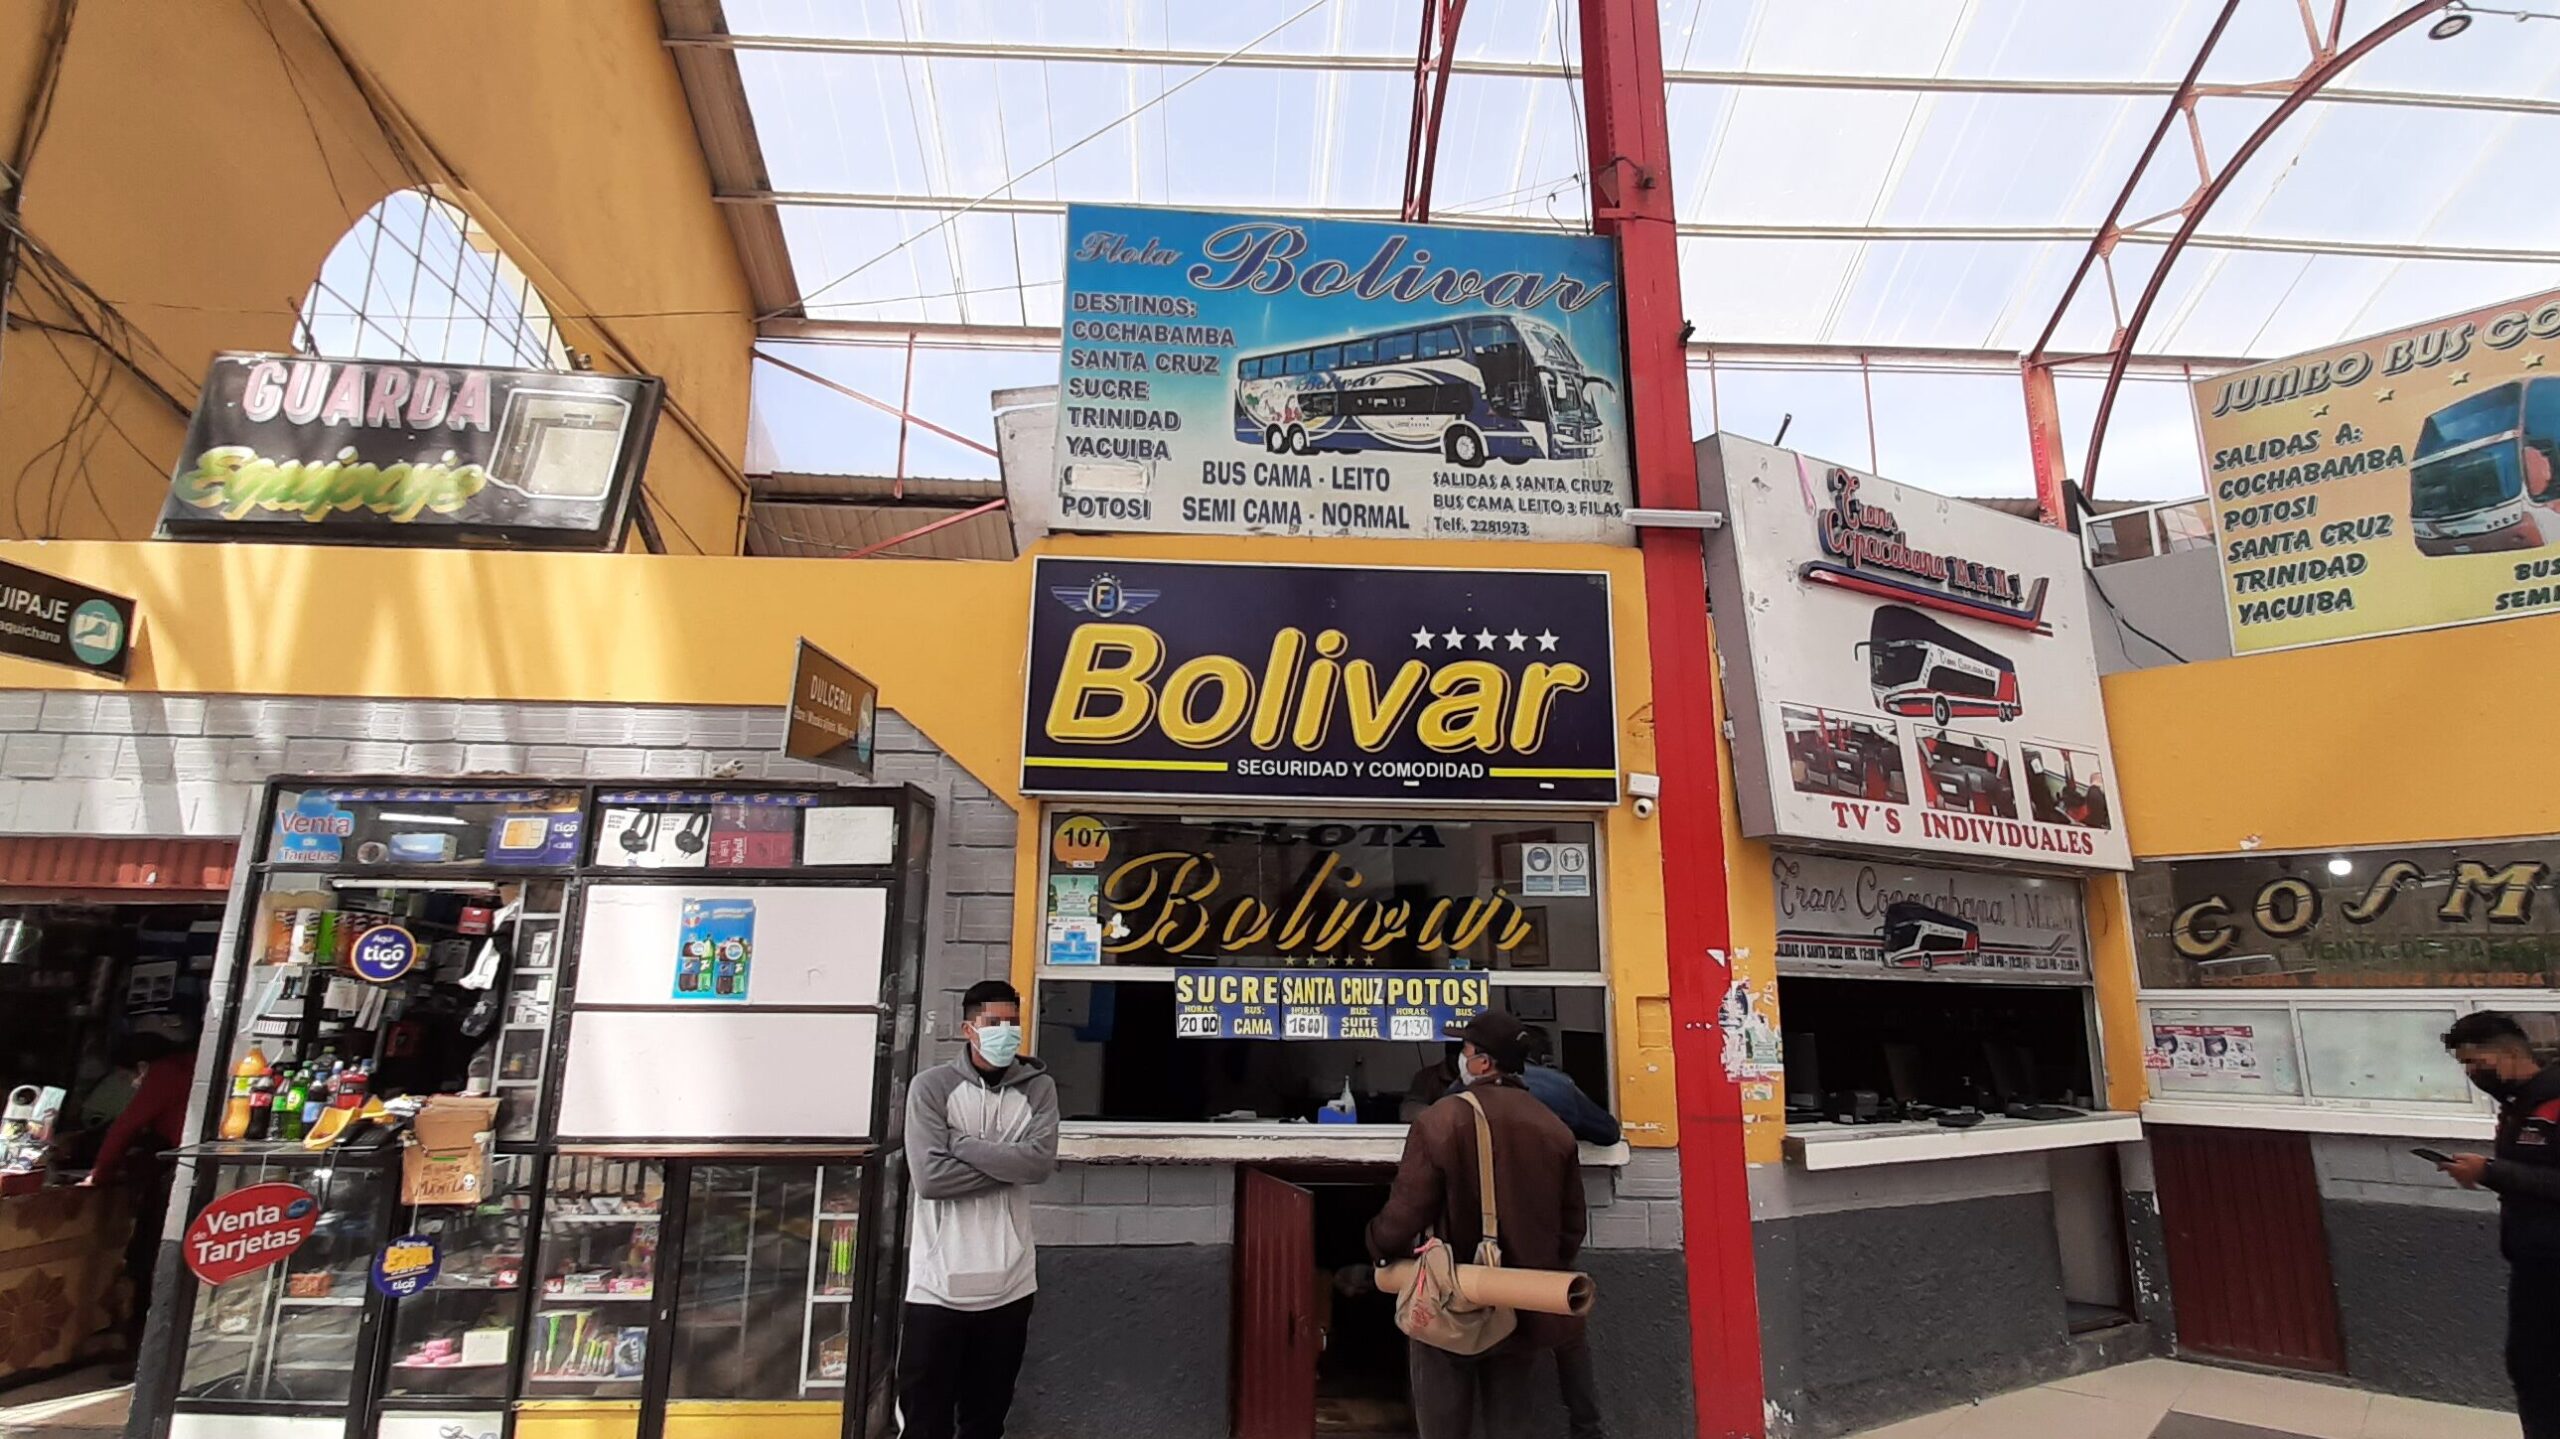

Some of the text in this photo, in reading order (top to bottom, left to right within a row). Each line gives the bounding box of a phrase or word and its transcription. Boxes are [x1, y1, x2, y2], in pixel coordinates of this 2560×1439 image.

[1075, 221, 1611, 313] Flota Bolivar
[1073, 292, 1198, 317] DESTINOS:
[1072, 320, 1237, 347] COCHABAMBA
[1071, 349, 1221, 376] SANTA CRUZ
[2212, 349, 2371, 418] JUMBO
[2381, 319, 2475, 377] BUS
[242, 358, 491, 433] GUARDA
[1069, 378, 1150, 400] SUCRE
[1067, 406, 1181, 431] TRINIDAD
[1066, 436, 1171, 461] YACUIBA
[2213, 422, 2363, 471] SALIDAS A:
[1202, 461, 1246, 486] BUS
[1253, 463, 1312, 488] CAMA
[1332, 466, 1390, 491] LEITO
[1433, 472, 1614, 495] SALIDAS A SANTA CRUZ
[2218, 444, 2406, 501] COCHABAMBA
[1062, 496, 1151, 520] POTOSI
[1182, 497, 1236, 522] SEMI
[1243, 499, 1302, 525] CAMA
[1322, 502, 1410, 529] NORMAL
[1433, 494, 1623, 518] BUS CAMA LEITO 3 FILAS
[2223, 495, 2317, 532] POTOSI
[1434, 517, 1530, 535] Telf. 2281973
[2227, 514, 2394, 563] SANTA CRUZ
[1818, 507, 1948, 581] Copacabana
[2233, 552, 2368, 594] TRINIDAD
[2238, 587, 2355, 626] YACUIBA
[810, 675, 853, 717] DULCERIA
[1045, 622, 1589, 754] Bolivar
[1237, 760, 1484, 779] SEGURIDAD Y COMODIDAD
[279, 810, 351, 834] Venta
[1920, 812, 2094, 856] INDIVIDUALES
[1064, 827, 1106, 848] 107
[1772, 855, 1847, 919] Trans
[1098, 849, 1532, 955] Bolivar
[363, 944, 406, 967] tigo
[1176, 975, 1278, 1004] SUCRE
[1282, 976, 1384, 1005] SANTA CRUZ
[1387, 978, 1488, 1007] POTOSI
[1234, 1018, 1273, 1035] CAMA
[1340, 1028, 1379, 1038] CAMA
[1341, 1017, 1378, 1028] SUITE
[206, 1205, 281, 1235] Venta
[195, 1228, 302, 1265] Tarjetas
